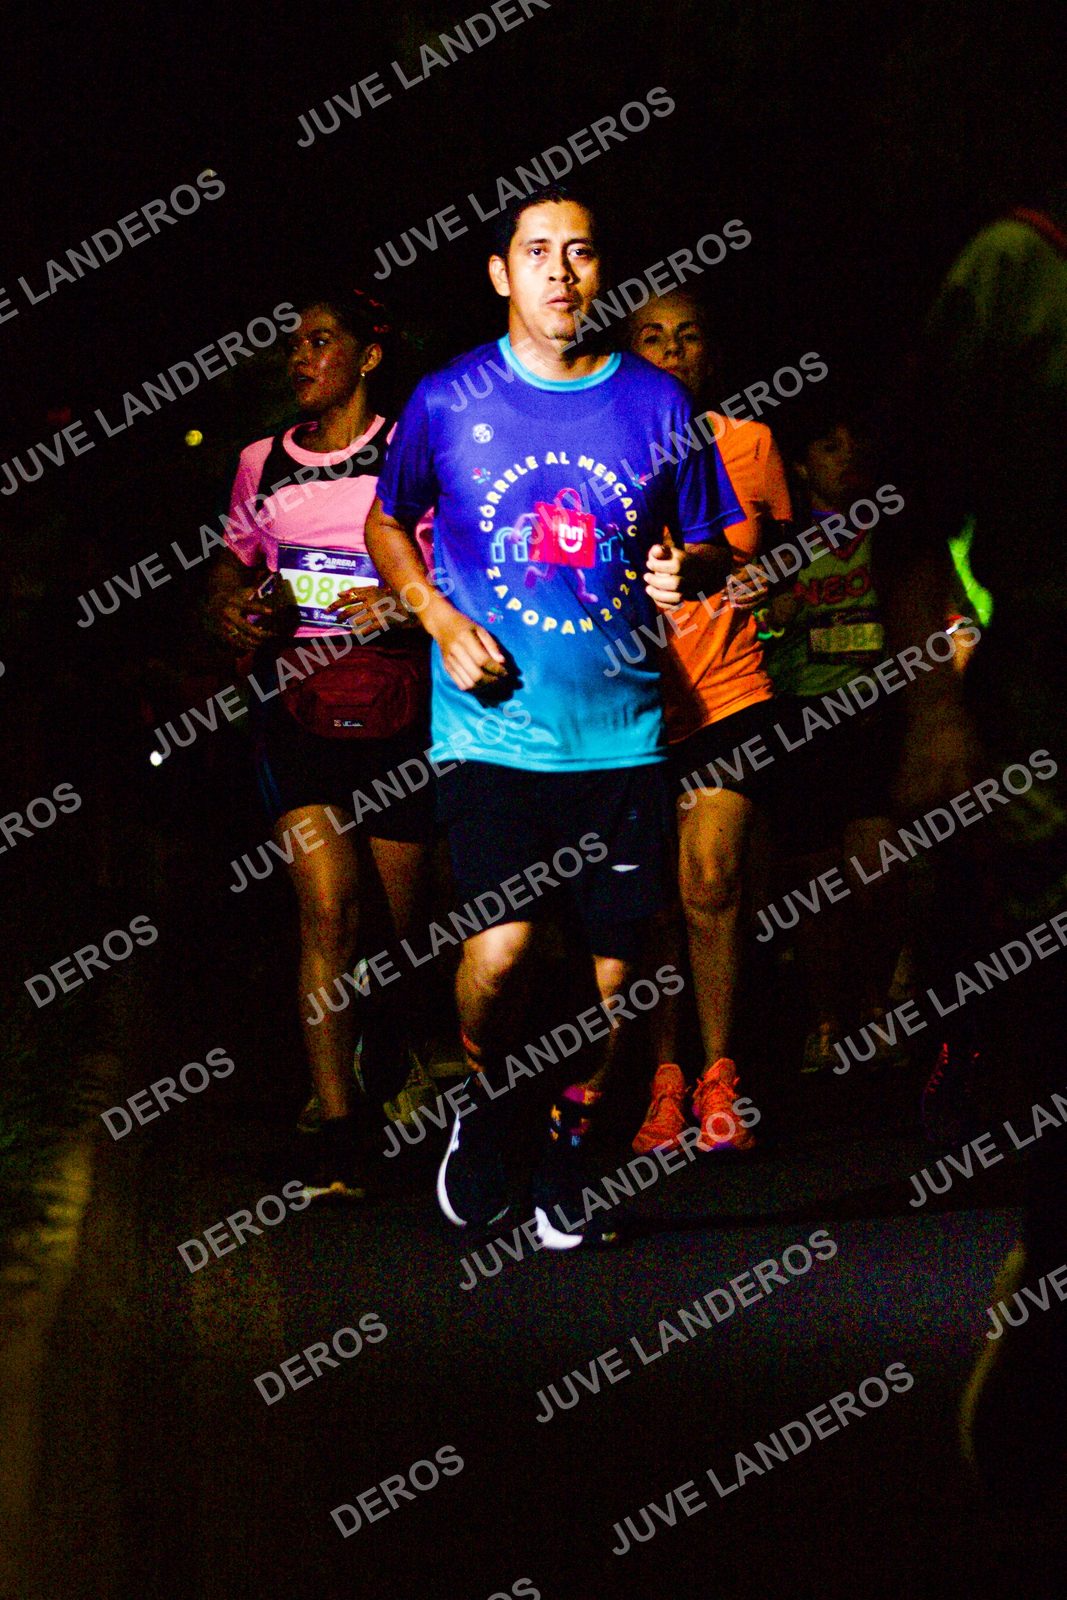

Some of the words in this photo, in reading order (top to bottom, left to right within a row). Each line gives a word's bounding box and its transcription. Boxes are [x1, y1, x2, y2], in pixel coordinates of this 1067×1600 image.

[545, 451, 571, 465] AL
[486, 565, 594, 635] ZAPOPAN
[600, 568, 639, 623] 2026
